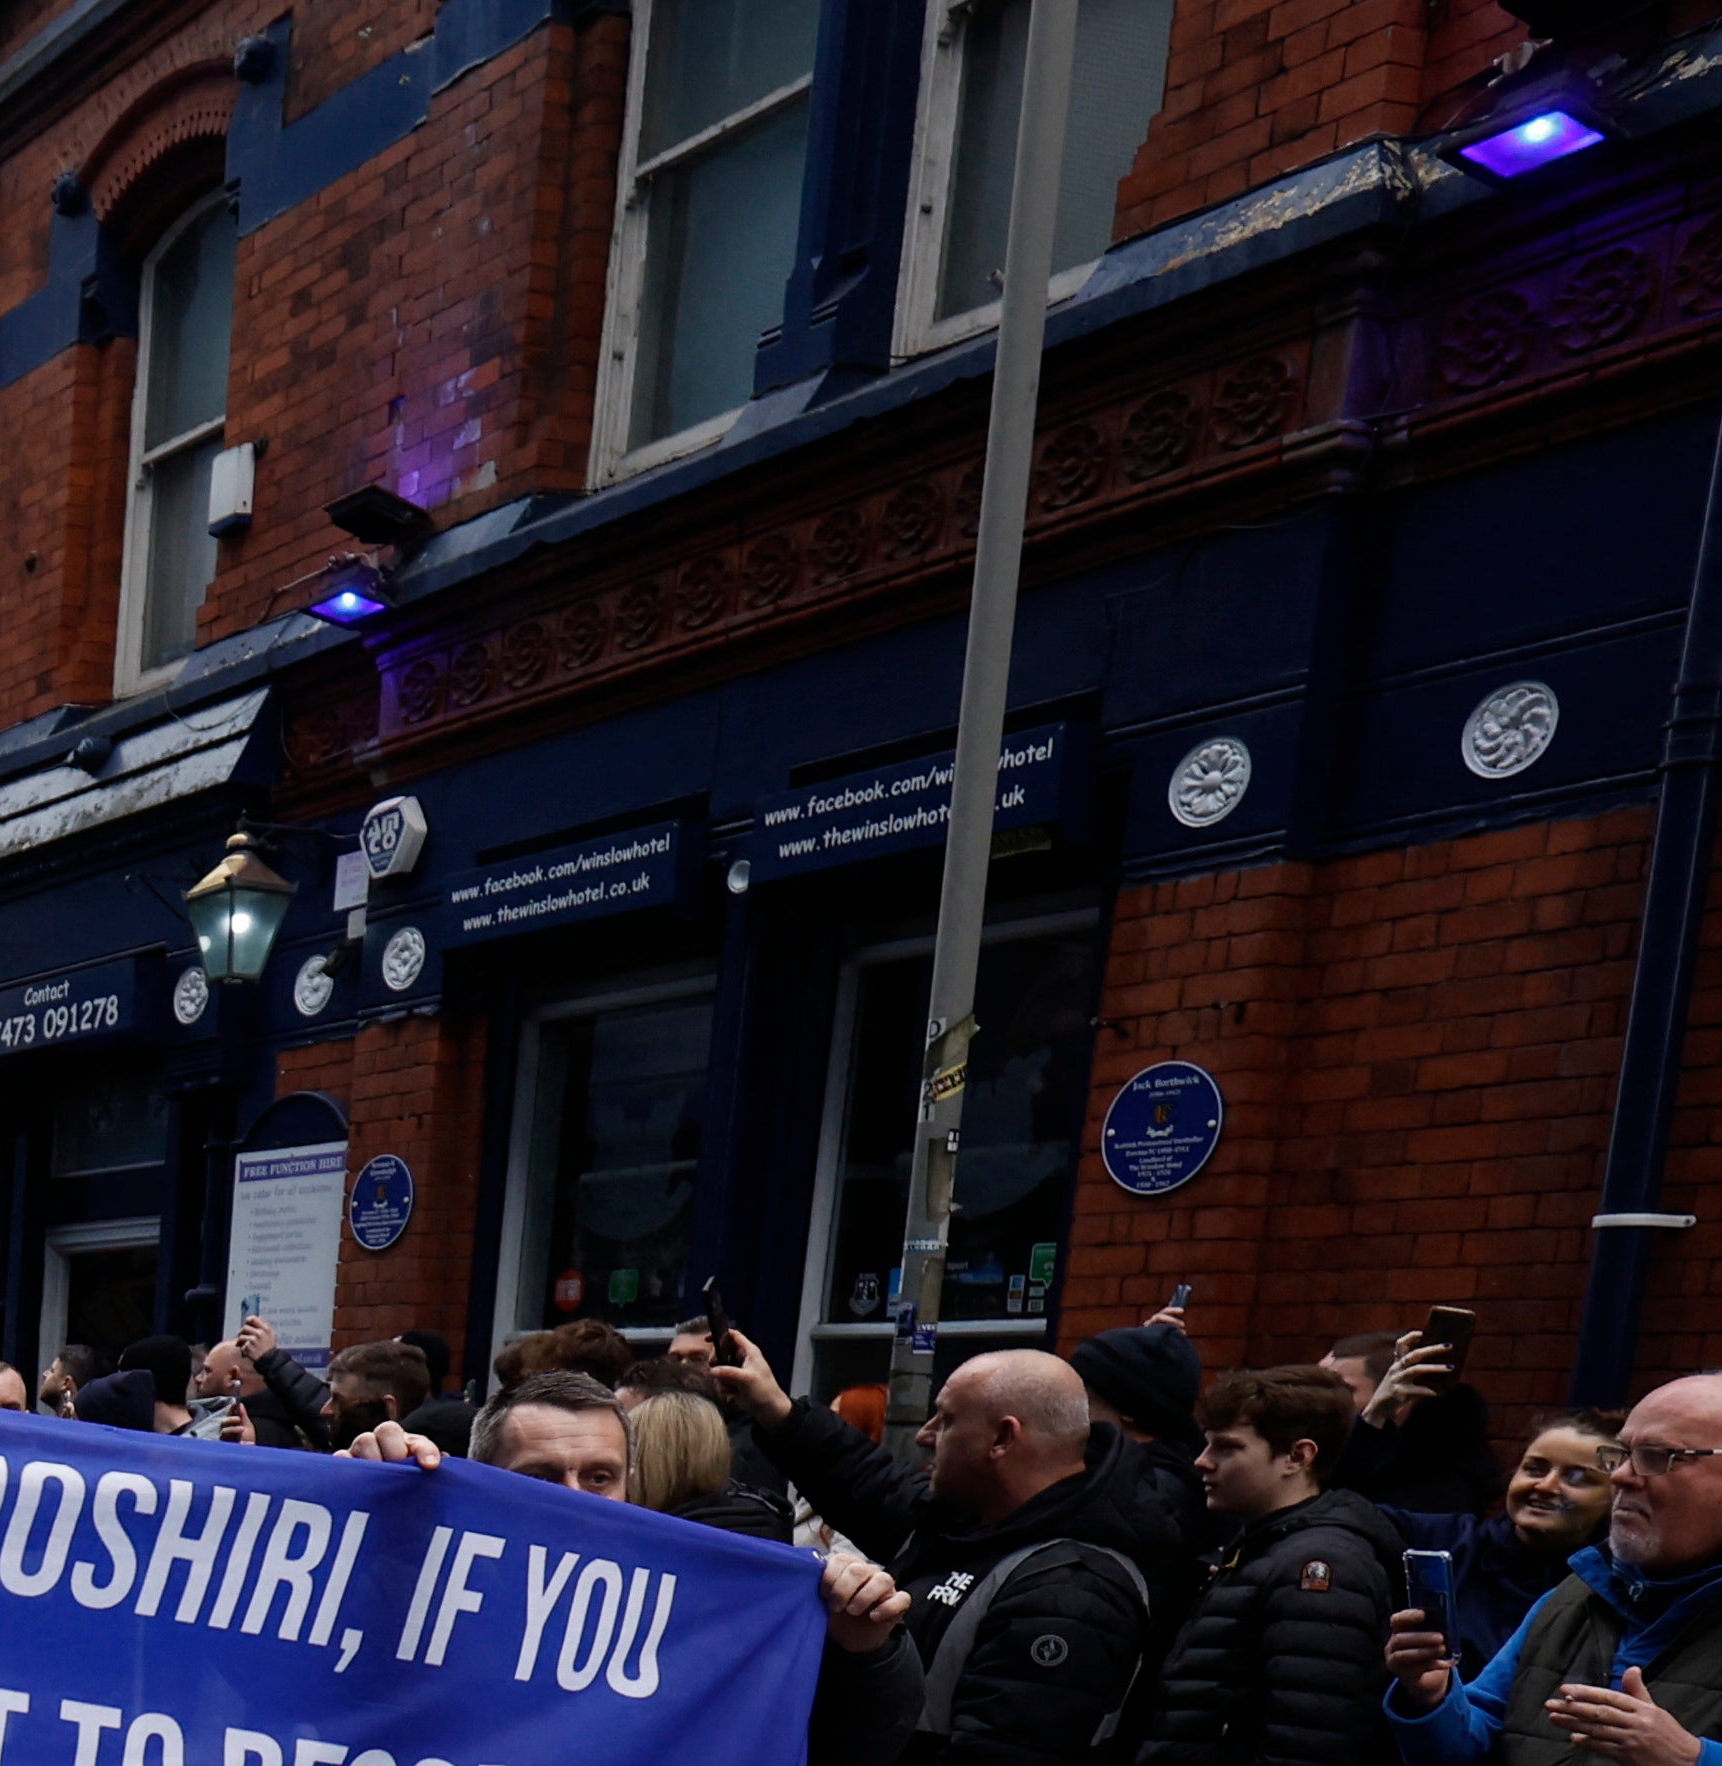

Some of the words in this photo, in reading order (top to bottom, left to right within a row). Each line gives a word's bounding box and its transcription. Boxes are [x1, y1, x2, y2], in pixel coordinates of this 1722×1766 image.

[451, 832, 671, 904] www.facebook.com/winslowhotel
[462, 871, 651, 932] www.thewinslowhotel.co.uk
[24, 979, 70, 1006] Contact
[43, 996, 119, 1040] 091278
[243, 1164, 268, 1179] FREE
[270, 1159, 317, 1175] FUNCTION
[318, 1156, 343, 1169] HIRE
[945, 1571, 975, 1591] THE
[397, 1526, 506, 1666] IF
[515, 1545, 677, 1699] YOU
